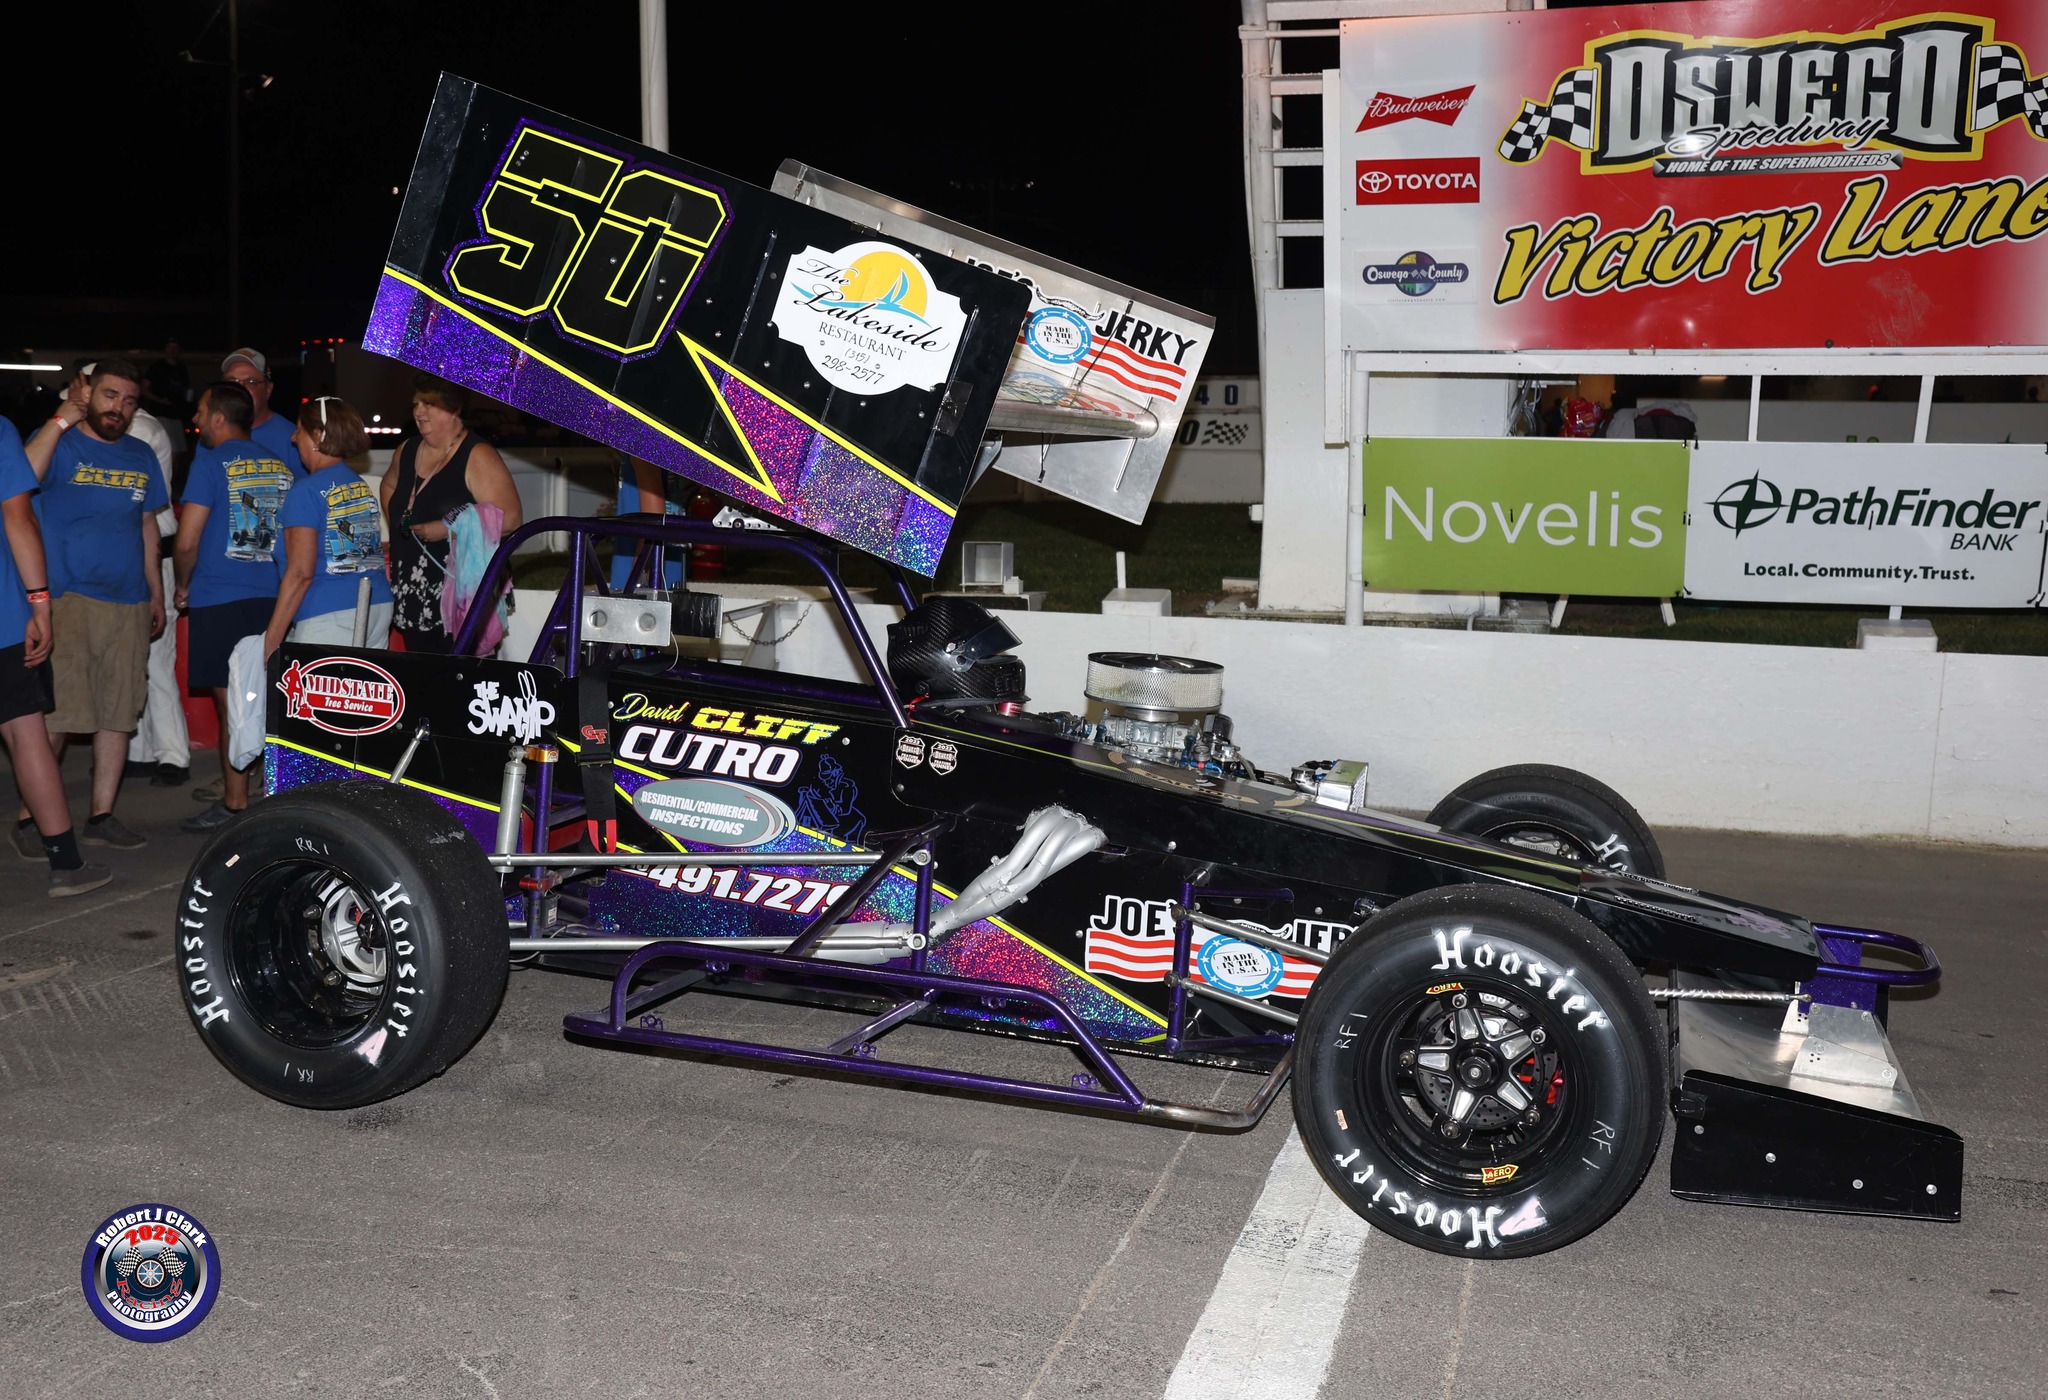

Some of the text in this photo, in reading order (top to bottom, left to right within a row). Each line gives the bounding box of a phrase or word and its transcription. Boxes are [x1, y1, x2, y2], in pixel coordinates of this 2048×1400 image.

[1366, 95, 1469, 118] Budweiser
[1603, 28, 1973, 160] OSWEGO
[1666, 115, 1888, 160] Speedway
[1665, 153, 1892, 174] HOME OF THE SUPERMODIFIEDS
[1394, 172, 1477, 190] TOYOTA
[448, 124, 728, 357] 50
[1497, 205, 1820, 304] Victory
[797, 258, 859, 287] The
[1367, 264, 1465, 283] Oswego County
[793, 283, 950, 353] Lakeside
[1045, 325, 1071, 334] MADE
[818, 321, 907, 361] RESTAURANT
[1043, 330, 1073, 340] IN THE
[1046, 336, 1073, 346] U.S.A.
[1095, 310, 1198, 366] JERKY
[821, 354, 885, 385] 298-2577
[844, 348, 871, 364] (315)
[1384, 485, 1663, 549] Novelis
[1785, 485, 2041, 531] PathFinder
[1949, 532, 2018, 552] BANK
[305, 674, 394, 701] MIDSTATE
[473, 681, 500, 701] THE
[324, 696, 374, 714] Tree Service
[467, 694, 555, 745] SWAMP
[612, 692, 841, 745] David CLIFF
[618, 724, 801, 784] CUTRO
[641, 790, 760, 823] RESIDENTIAL/COMMERCIAL
[649, 808, 745, 837] INSPECTIONS
[295, 837, 319, 855] RR
[1092, 898, 1193, 937] JOE'
[180, 878, 231, 1031] Hoosier
[370, 880, 424, 1038] Hoosier
[1222, 952, 1255, 962] MADE
[1222, 958, 1260, 969] IN THE
[1227, 965, 1262, 975] U.S.A.
[1430, 926, 1608, 1032] Hoosier
[1433, 982, 1458, 992] AERO
[1487, 1167, 1512, 1179] AERO
[1334, 1146, 1504, 1249] Hoosier
